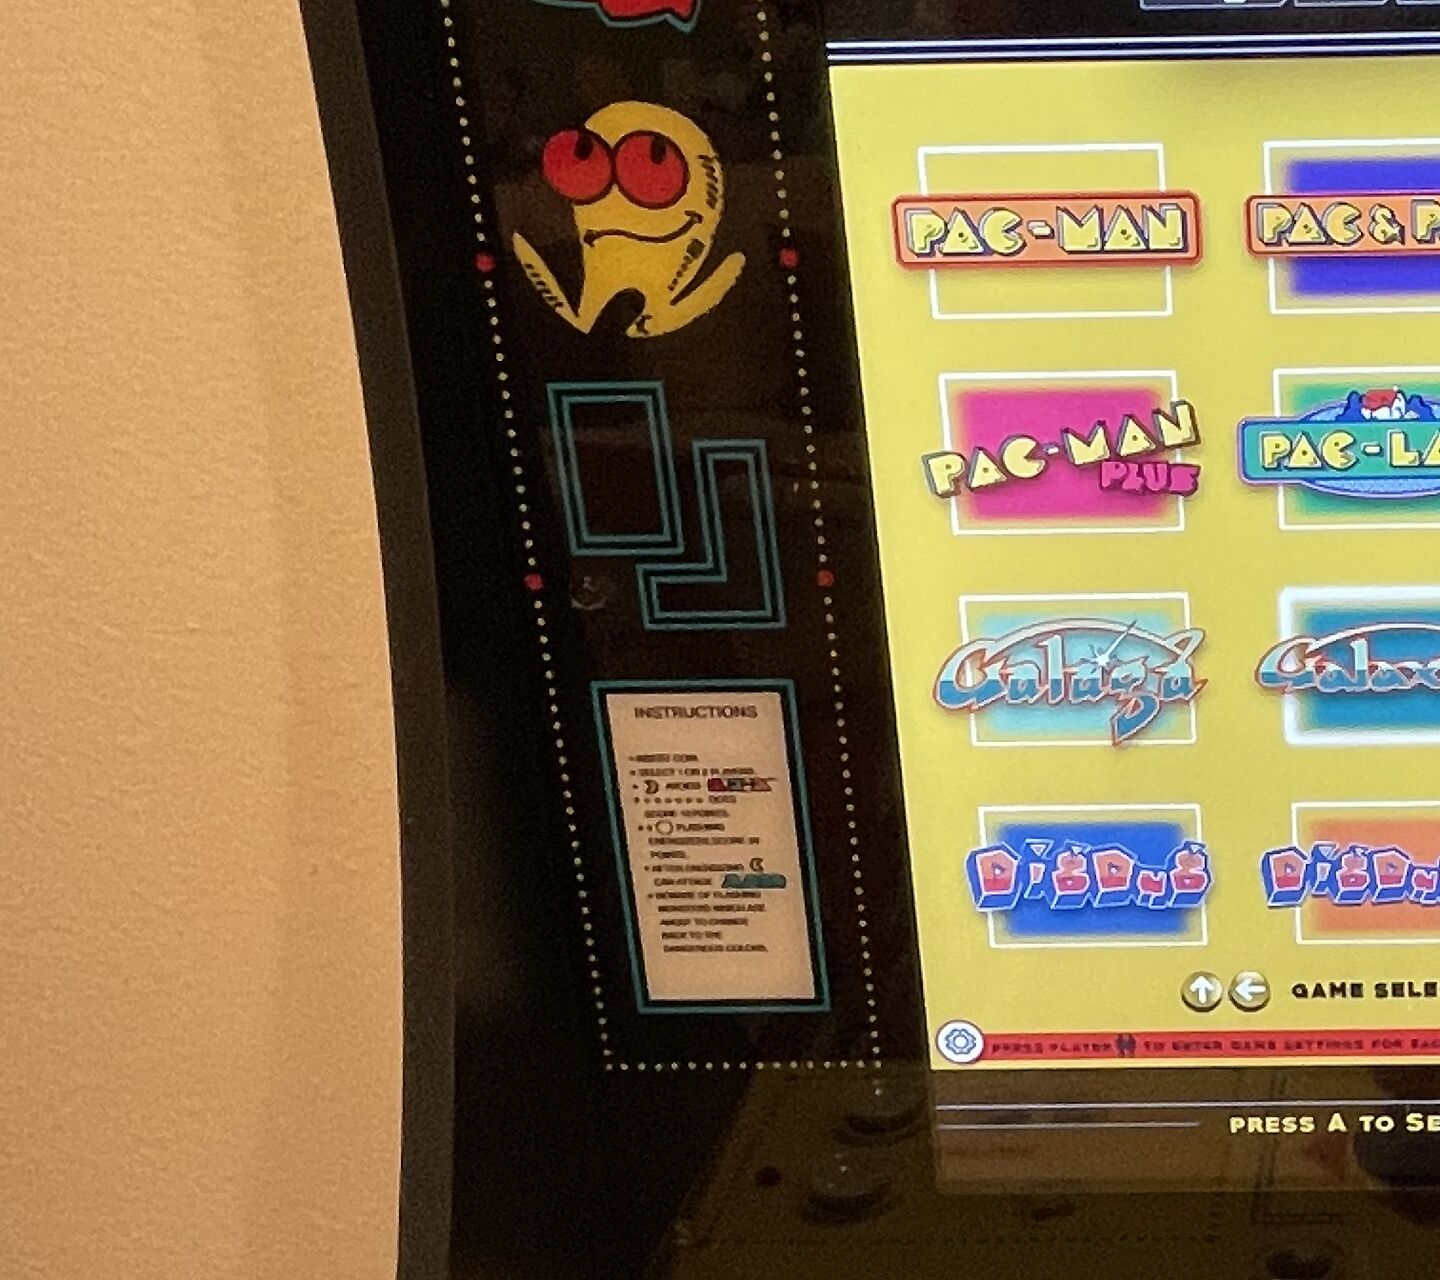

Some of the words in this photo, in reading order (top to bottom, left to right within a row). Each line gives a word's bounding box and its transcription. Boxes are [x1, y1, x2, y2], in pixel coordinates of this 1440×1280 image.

[905, 204, 1191, 256] PAC-MAN
[1256, 202, 1364, 246] PAC
[922, 400, 1200, 498] PAC-MAN
[1100, 460, 1200, 496] PLUS
[933, 617, 1208, 747] Galaga
[634, 705, 758, 719] INSTRUCTIONS
[1291, 981, 1364, 999] GAME
[1230, 1116, 1315, 1134] PRESS
[1328, 1113, 1347, 1132] A
[1359, 1115, 1395, 1132] TO
